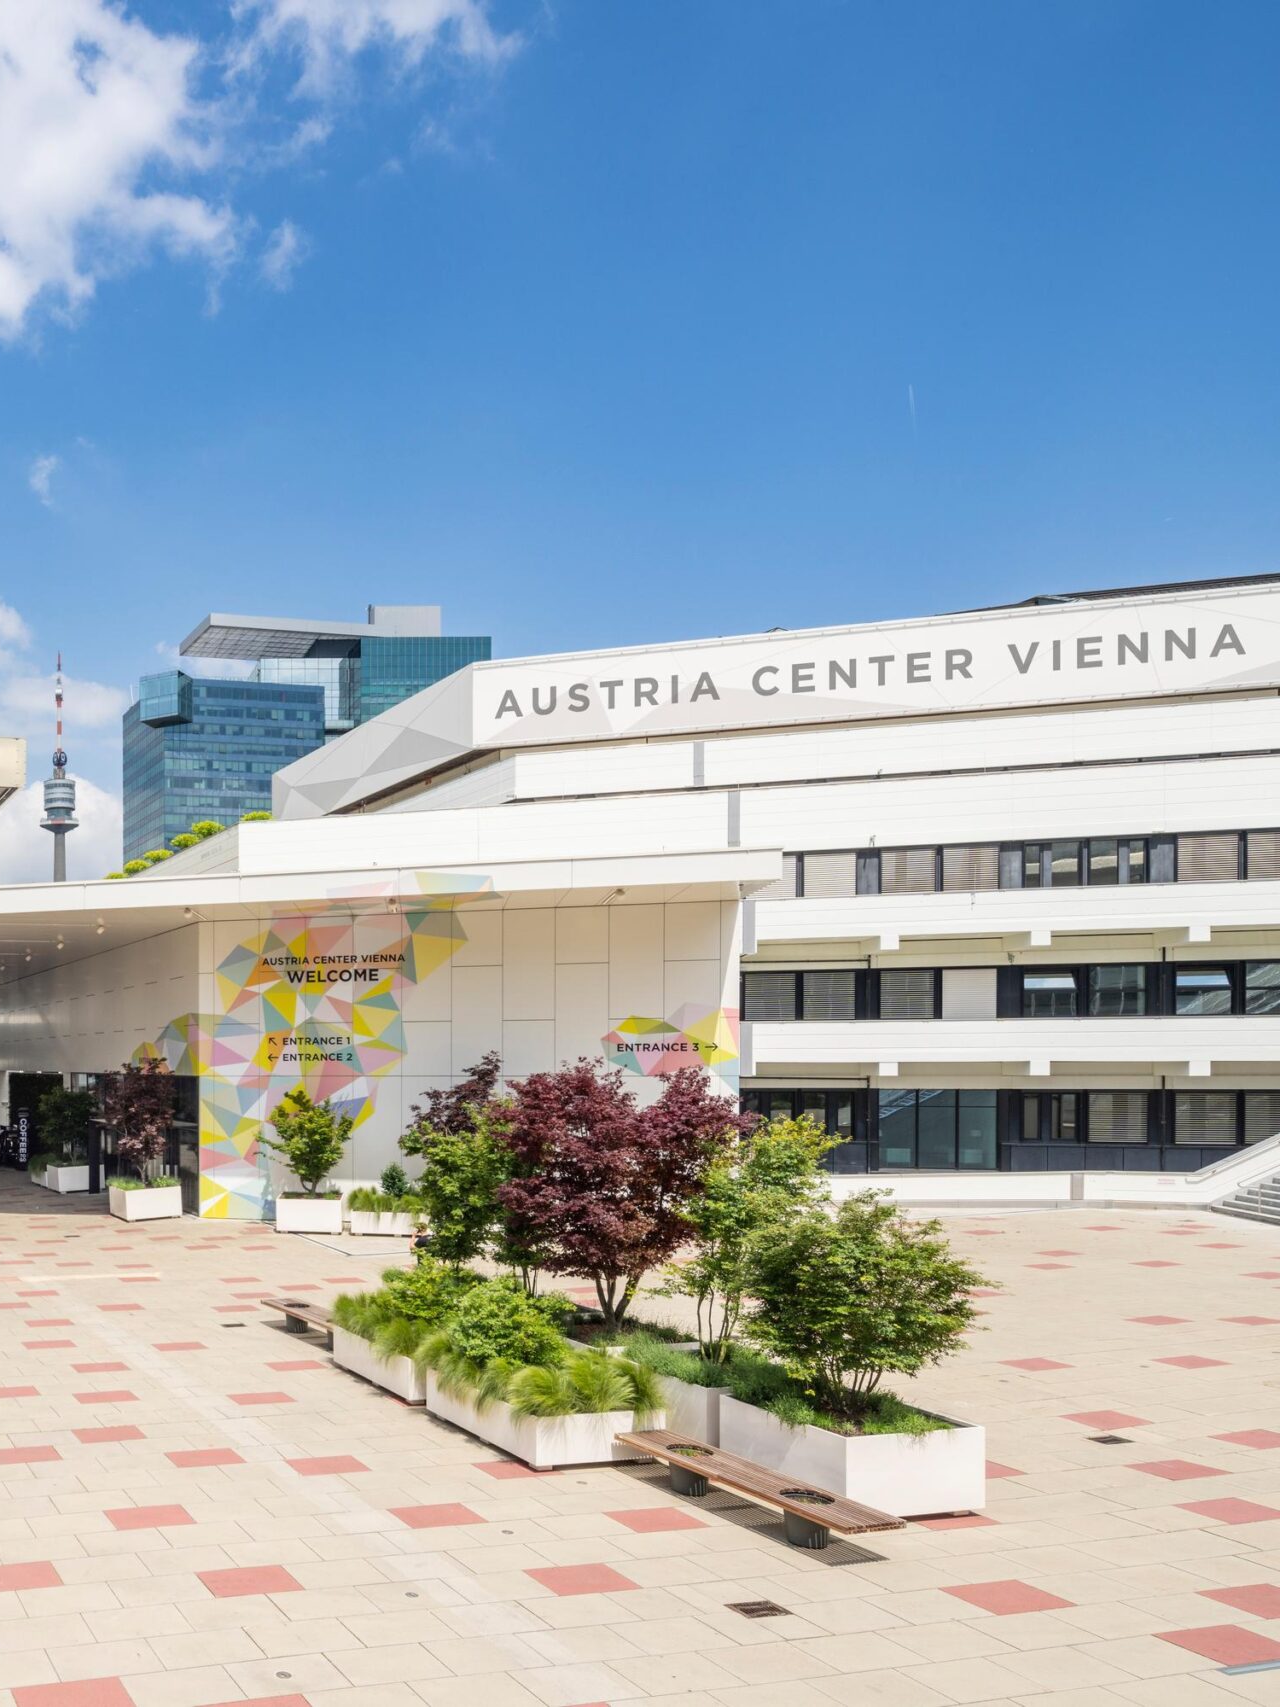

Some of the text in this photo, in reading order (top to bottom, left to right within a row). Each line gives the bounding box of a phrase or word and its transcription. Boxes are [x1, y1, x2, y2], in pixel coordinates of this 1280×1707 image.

[495, 624, 1246, 719] AUSTRIA CENTER VIENNA
[262, 954, 405, 966] AUSTRIA CENTER VIENNA
[287, 968, 379, 983] WELCOME
[282, 1036, 350, 1045] ENTRANCE 1
[617, 1043, 699, 1052] ENTRANCE 3
[282, 1053, 353, 1062] ENTRANCE 2
